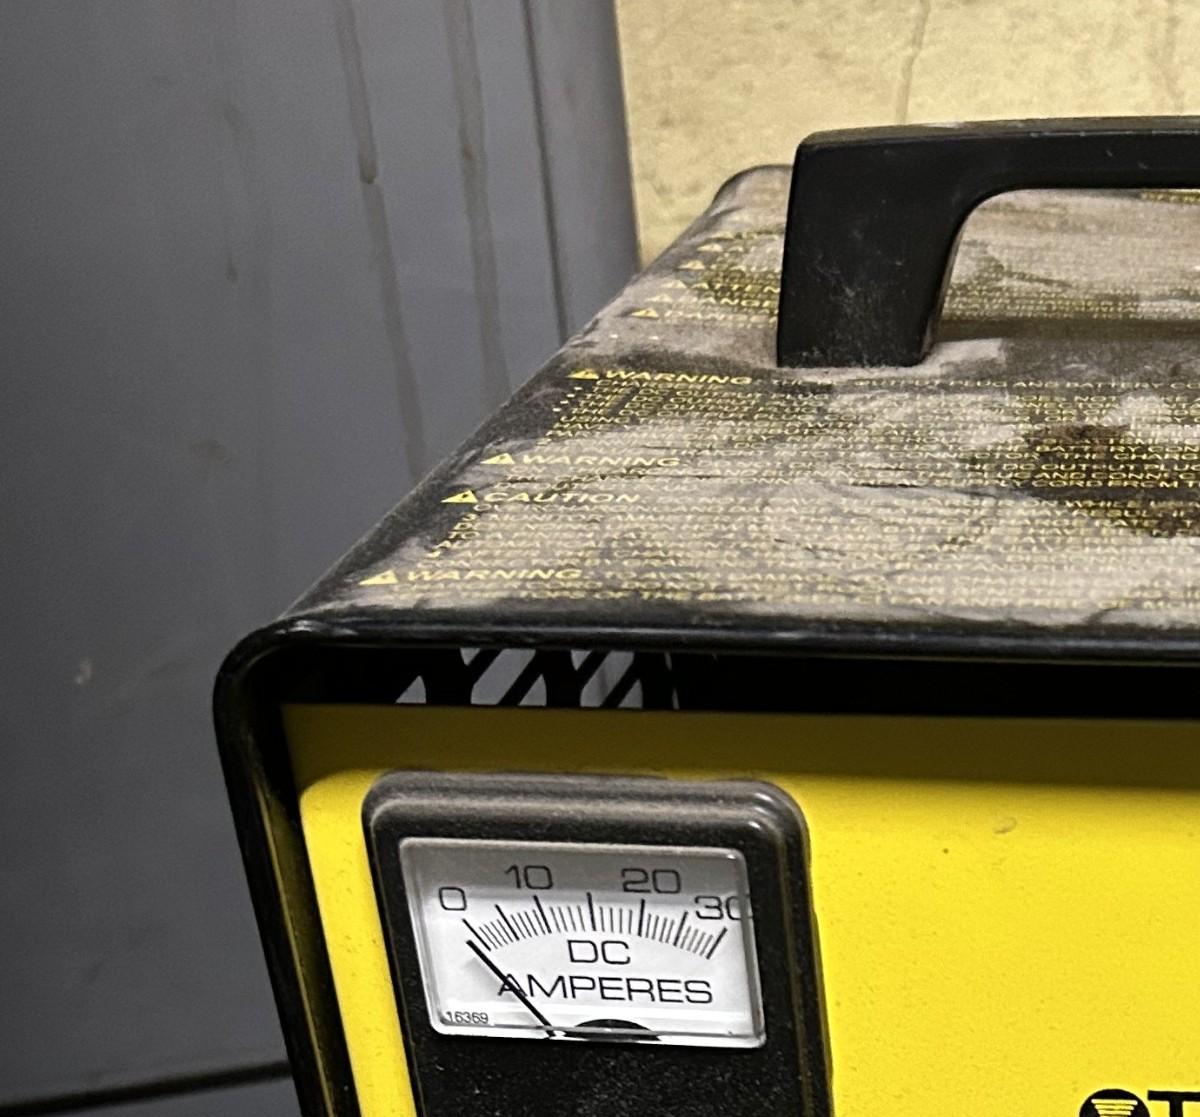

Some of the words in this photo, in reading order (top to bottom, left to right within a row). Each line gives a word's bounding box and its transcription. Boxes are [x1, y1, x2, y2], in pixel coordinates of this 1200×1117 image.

[605, 370, 752, 385] WARNING
[523, 454, 679, 468] WARNING
[484, 492, 641, 504] CAUTION
[407, 568, 583, 582] WARNING
[504, 864, 554, 891] 10
[621, 867, 682, 895] 20
[438, 886, 468, 912] 0
[567, 939, 632, 966] DC
[497, 973, 714, 1005] AMPERES
